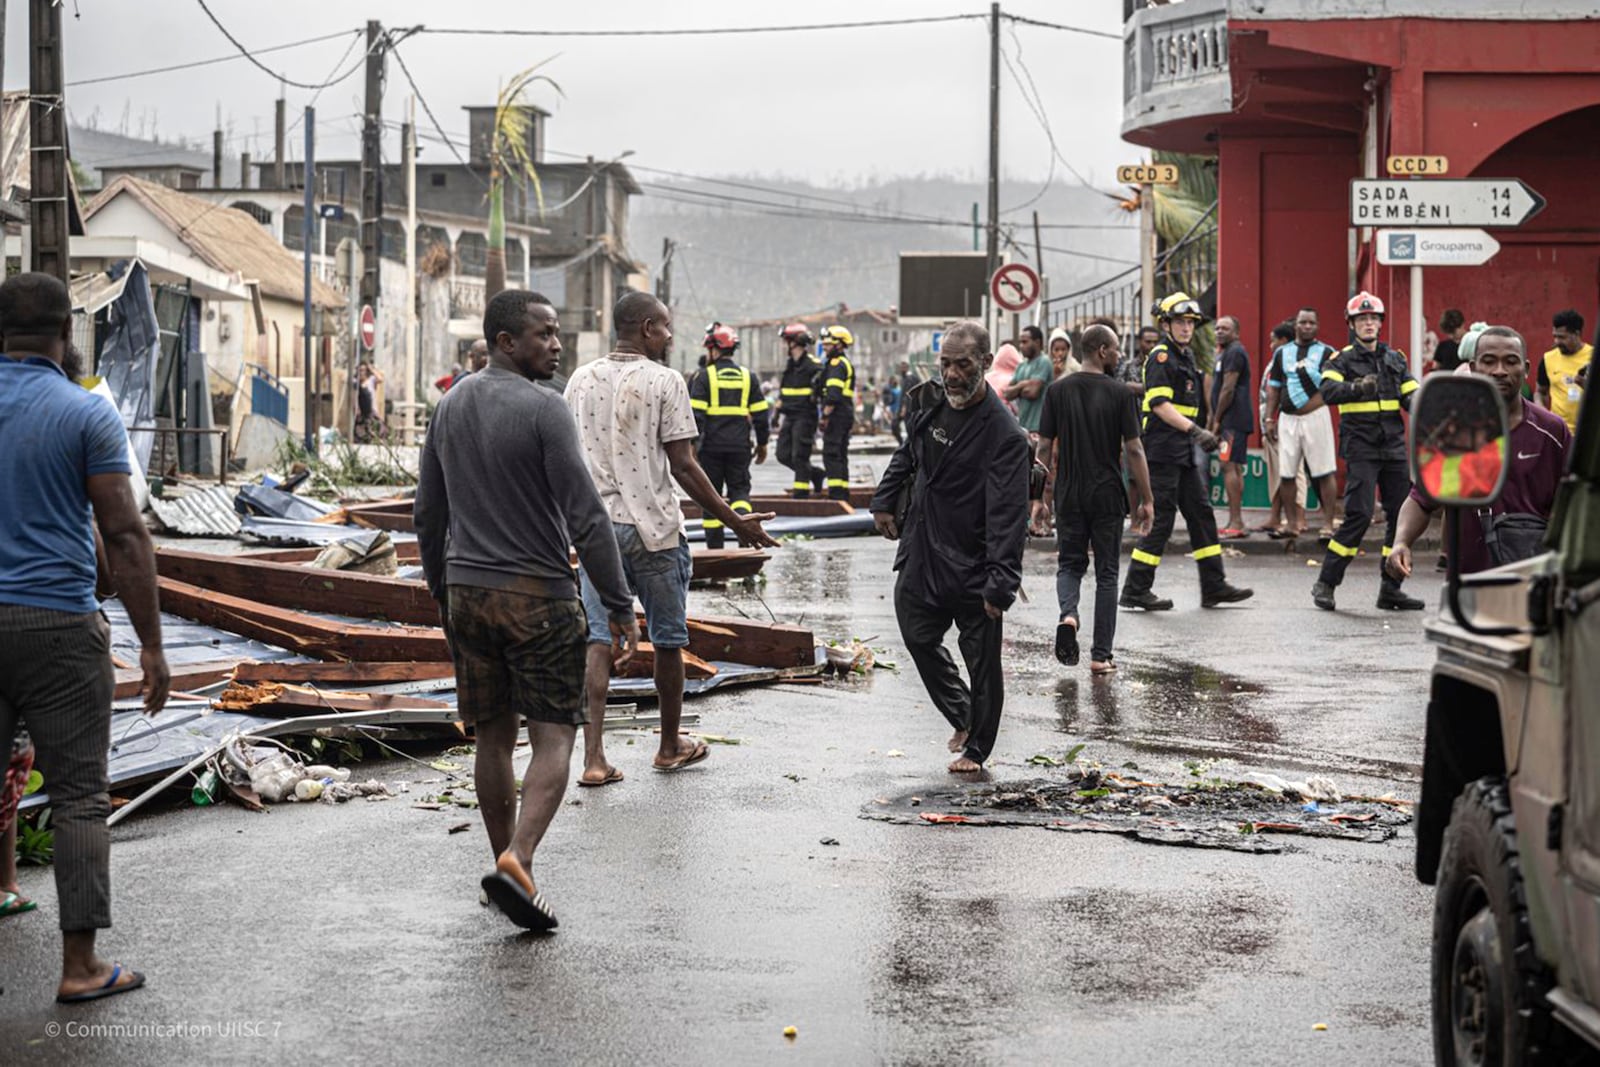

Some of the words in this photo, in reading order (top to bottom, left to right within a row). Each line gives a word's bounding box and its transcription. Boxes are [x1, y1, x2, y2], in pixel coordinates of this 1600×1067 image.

[1393, 158, 1427, 171] CCD
[1435, 158, 1442, 171] 1
[1122, 167, 1157, 181] CCD
[1165, 167, 1173, 181] 3
[1358, 187, 1409, 200] SADA
[1491, 187, 1511, 200] 14
[1358, 202, 1450, 218] DEMBÉNI
[1491, 204, 1511, 218] 14
[1420, 240, 1483, 252] Groupama
